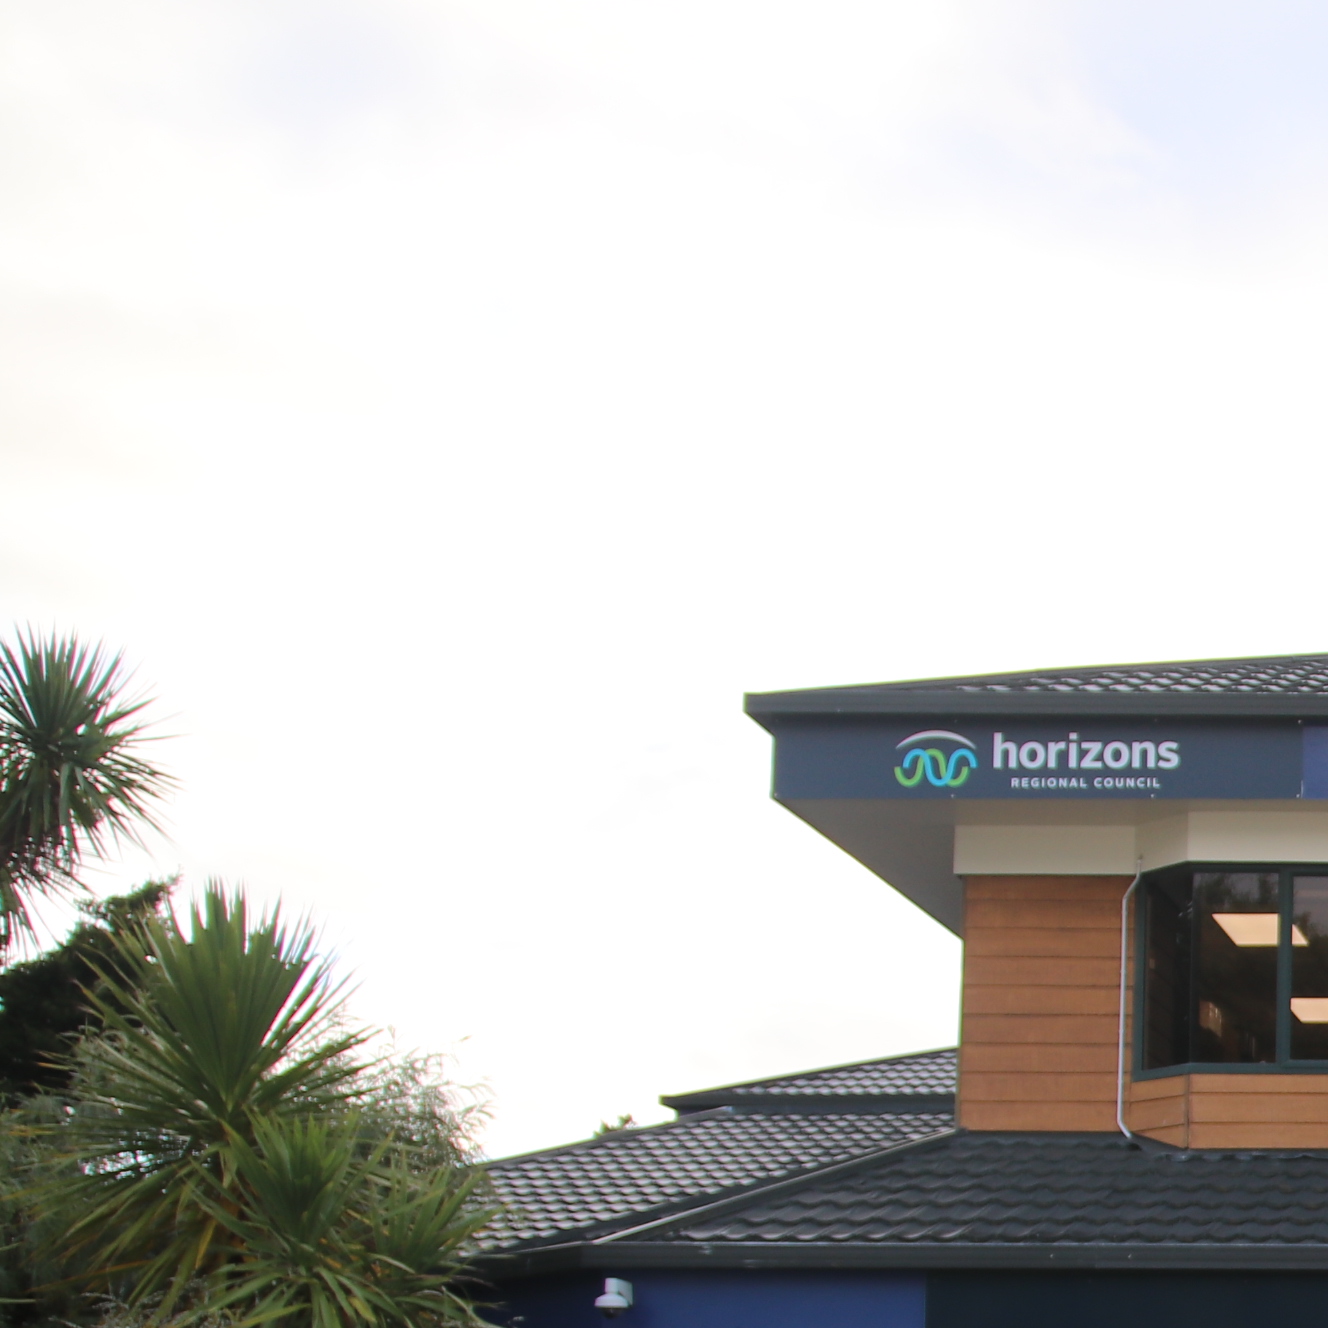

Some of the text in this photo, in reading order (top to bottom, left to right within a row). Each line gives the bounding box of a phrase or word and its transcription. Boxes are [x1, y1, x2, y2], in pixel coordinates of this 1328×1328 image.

[992, 732, 1180, 770] horizons
[1010, 776, 1161, 789] REGIONAL COUNCIL
